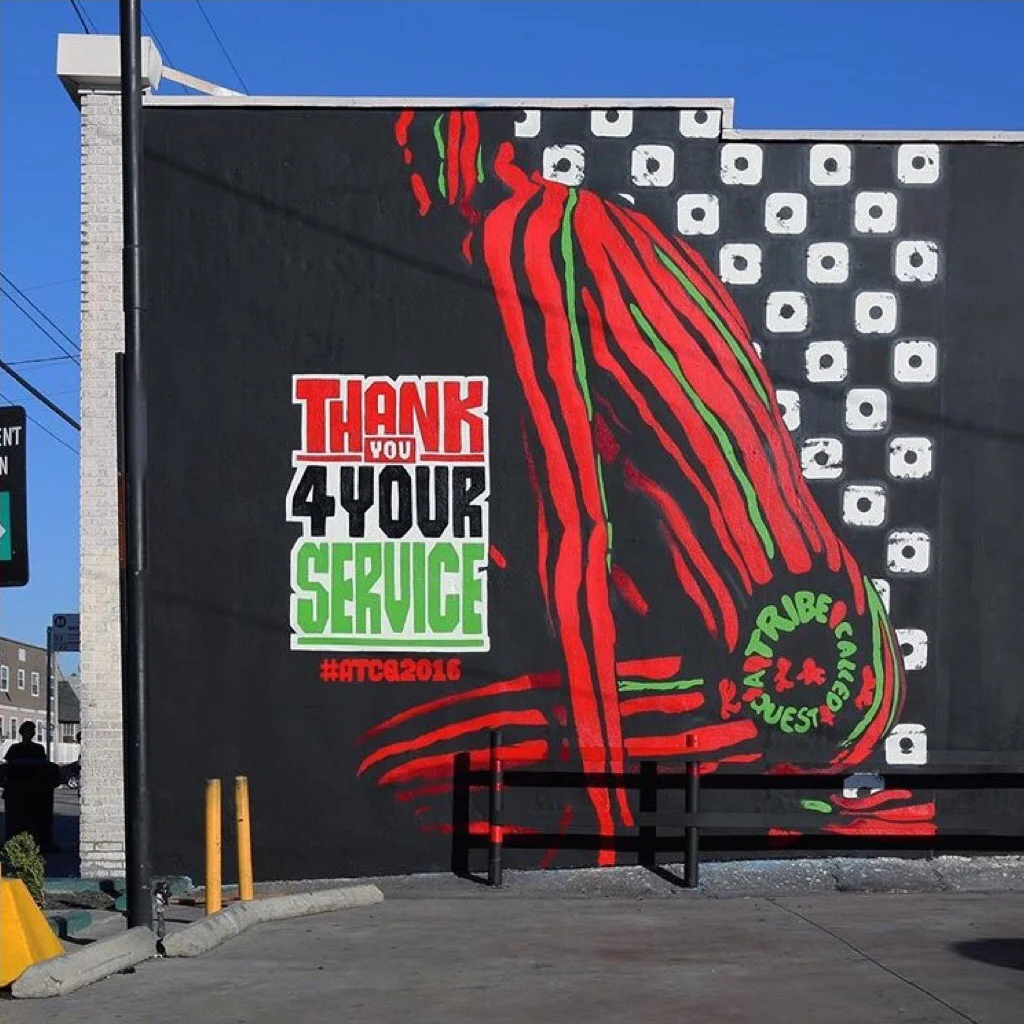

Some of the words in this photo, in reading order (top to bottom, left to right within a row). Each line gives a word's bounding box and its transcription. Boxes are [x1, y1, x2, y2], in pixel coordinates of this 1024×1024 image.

[0, 426, 22, 446] NT
[294, 378, 486, 455] THANK
[369, 440, 412, 461] YOU
[295, 541, 487, 636] SERVICE
[744, 590, 833, 659] TRIBE
[743, 670, 766, 689] A
[826, 621, 858, 712] CALLED
[750, 693, 820, 734] QUEST
